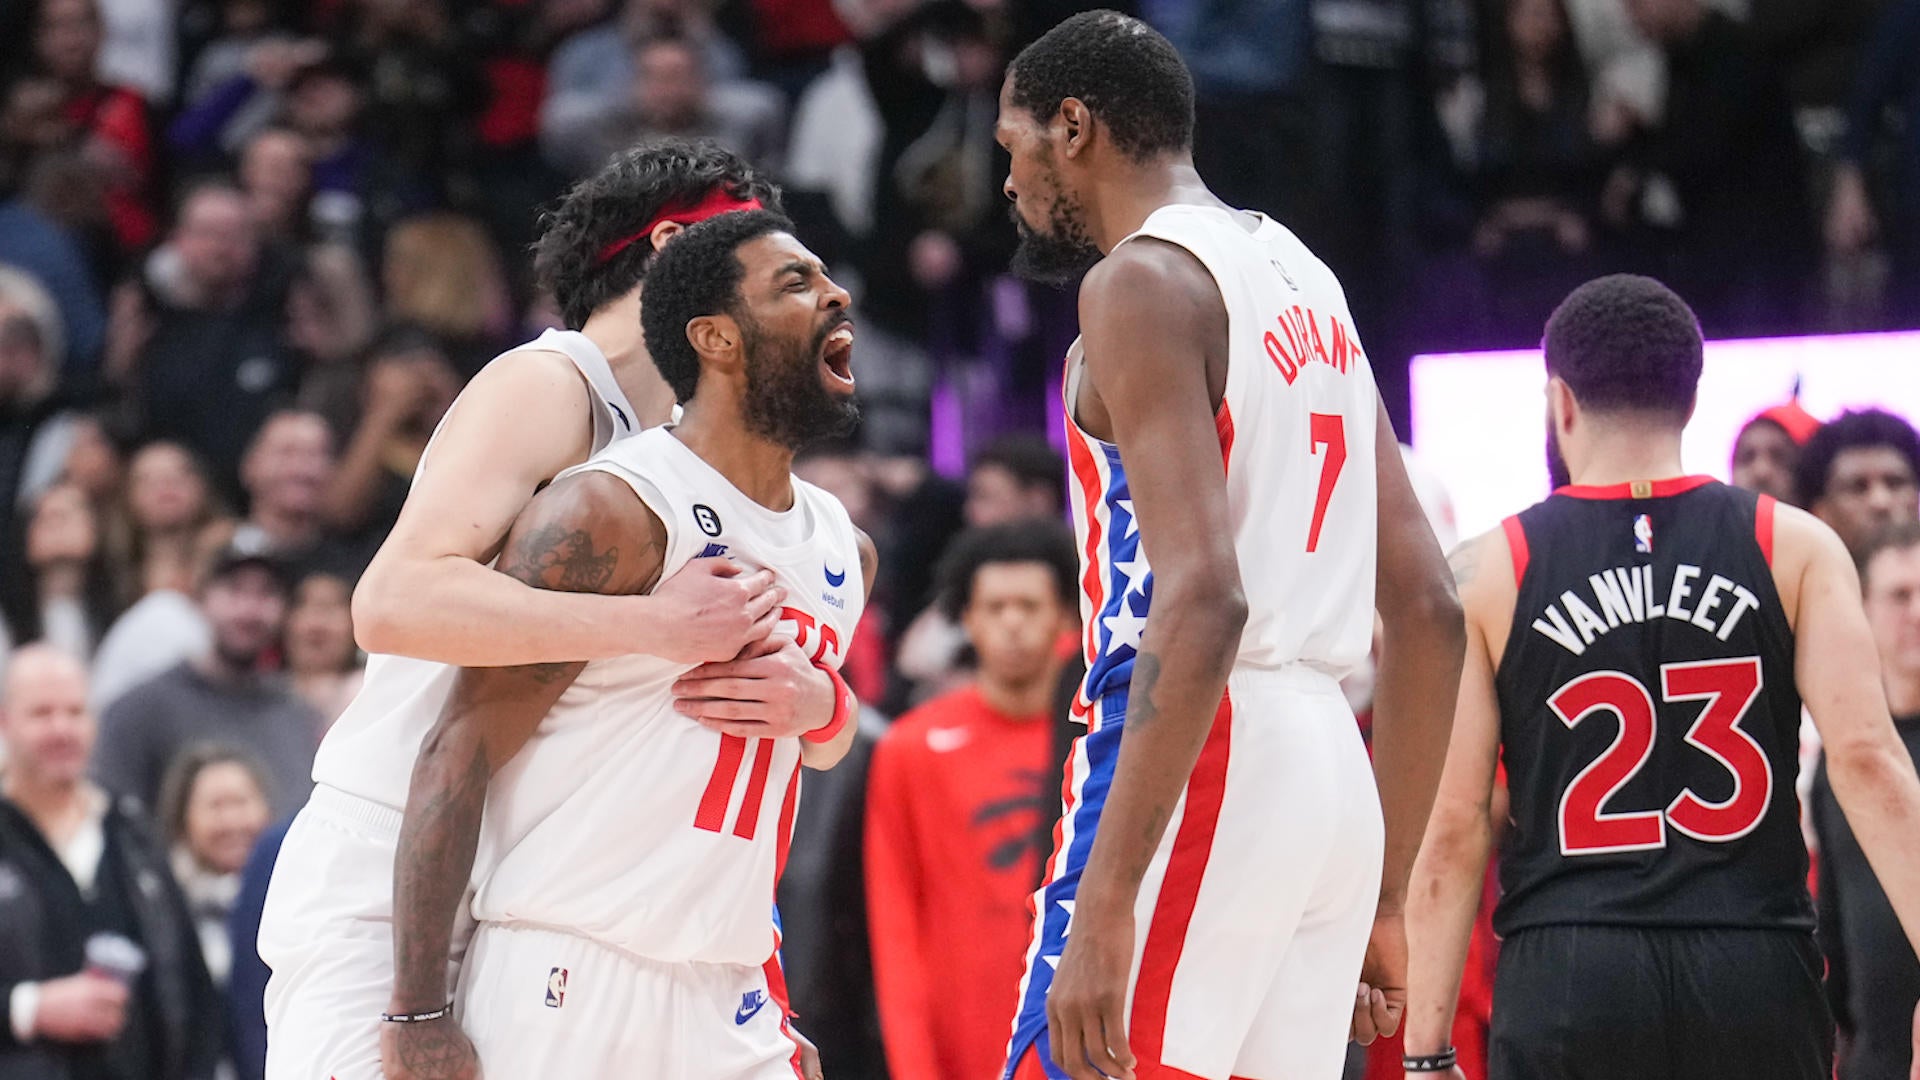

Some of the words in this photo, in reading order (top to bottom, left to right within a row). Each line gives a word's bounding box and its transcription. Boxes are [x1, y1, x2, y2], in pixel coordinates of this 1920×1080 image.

[1263, 305, 1361, 386] DURANT
[695, 507, 718, 534] 6
[1306, 412, 1347, 553] 7
[1532, 564, 1760, 656] VANVLEET
[693, 731, 775, 841] 11
[1546, 655, 1774, 856] 23
